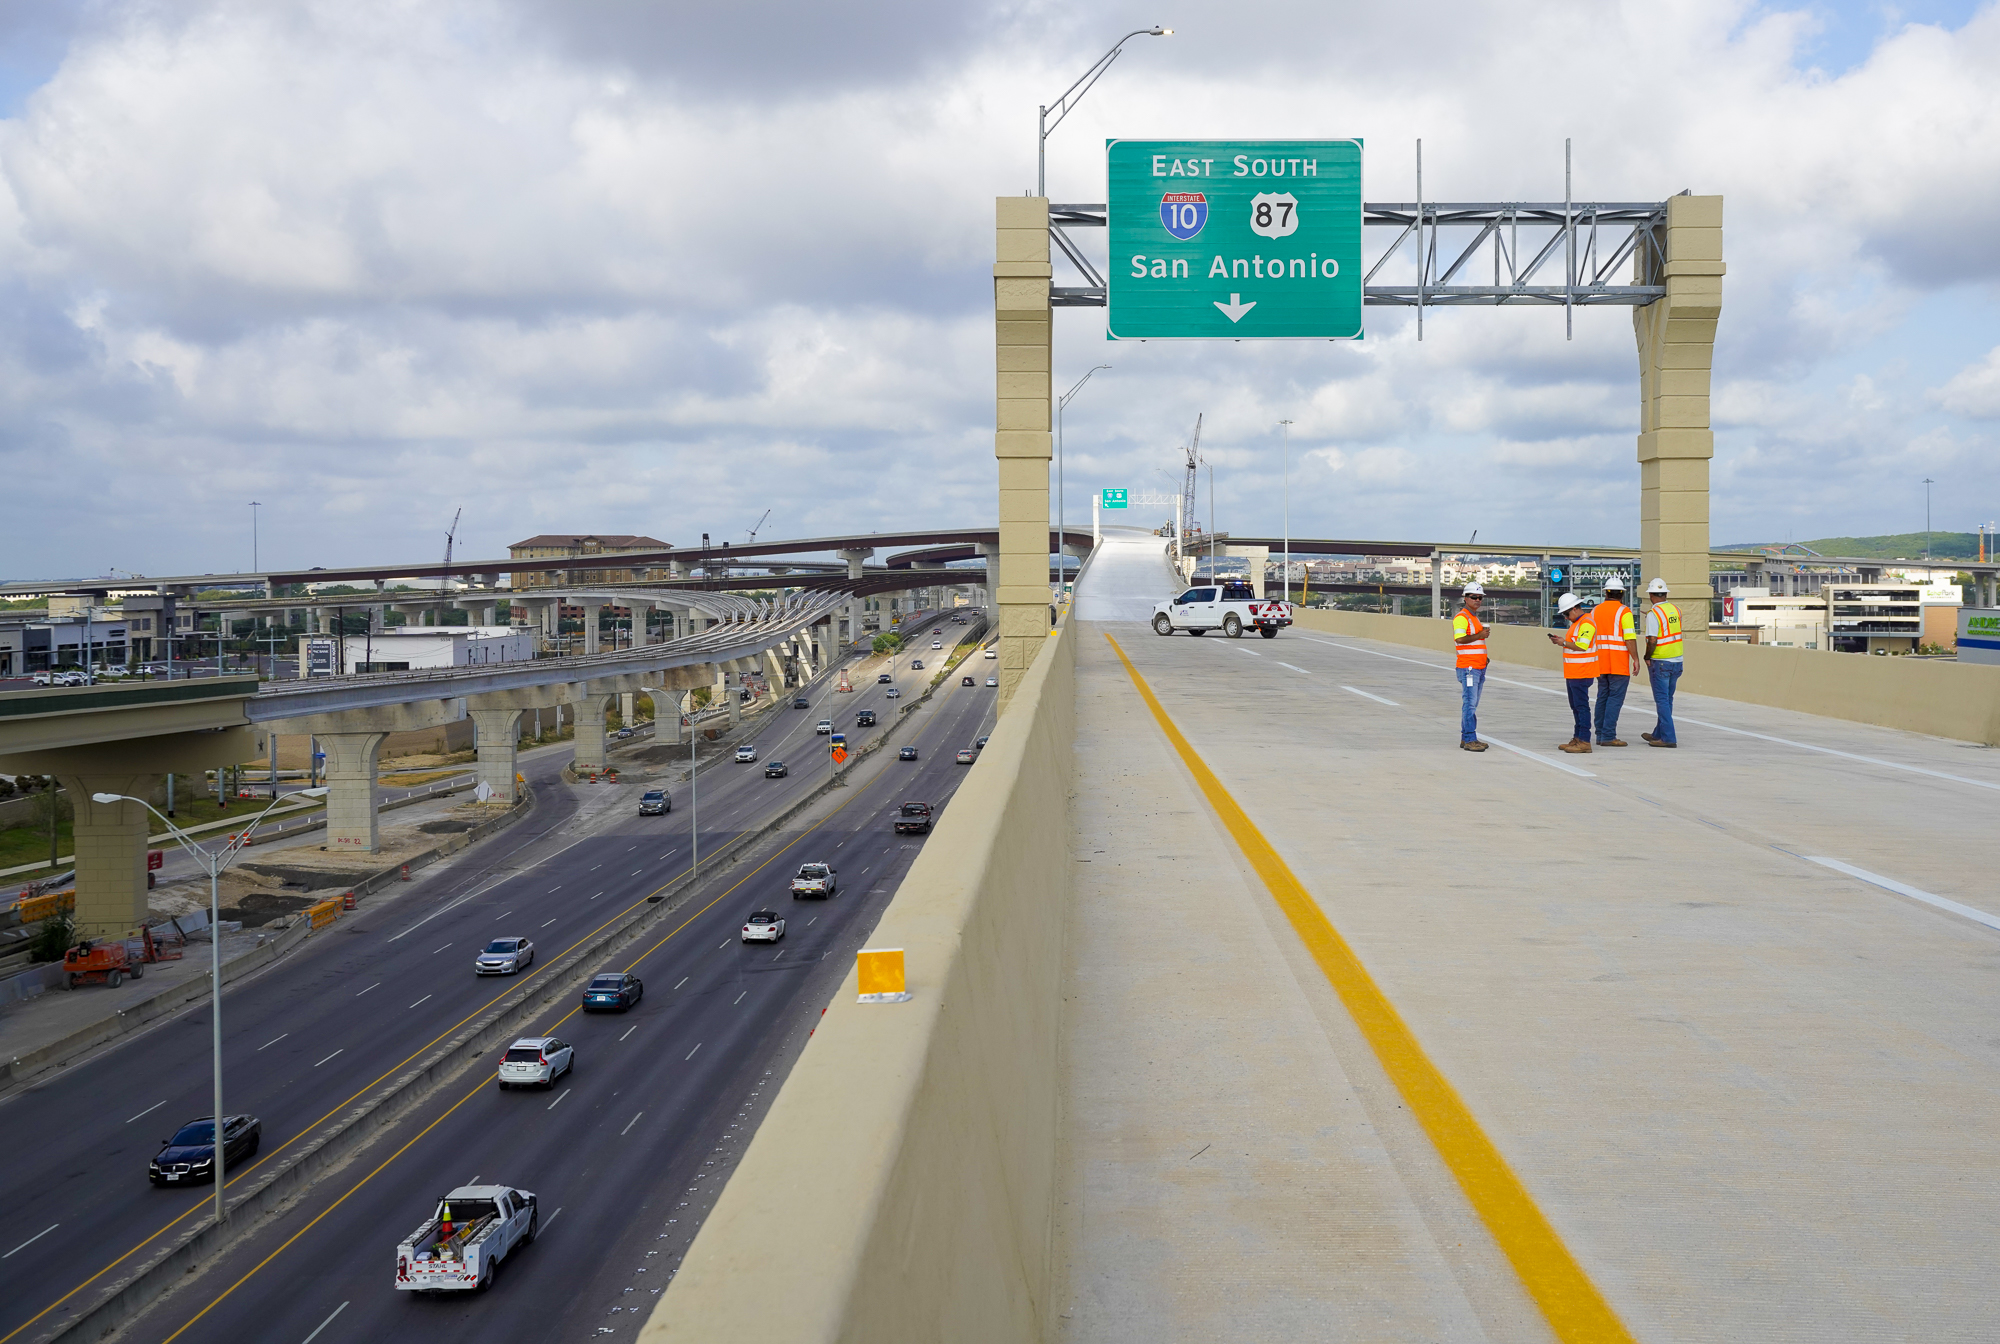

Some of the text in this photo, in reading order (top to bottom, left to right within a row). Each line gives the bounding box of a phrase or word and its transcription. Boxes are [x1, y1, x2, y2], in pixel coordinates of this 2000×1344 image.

[1152, 154, 1317, 177] EAST SOUTH
[1170, 203, 1198, 229] 10
[1255, 202, 1293, 228] 87
[1131, 253, 1339, 279] San Antonio
[1574, 571, 1630, 580] CARVANA
